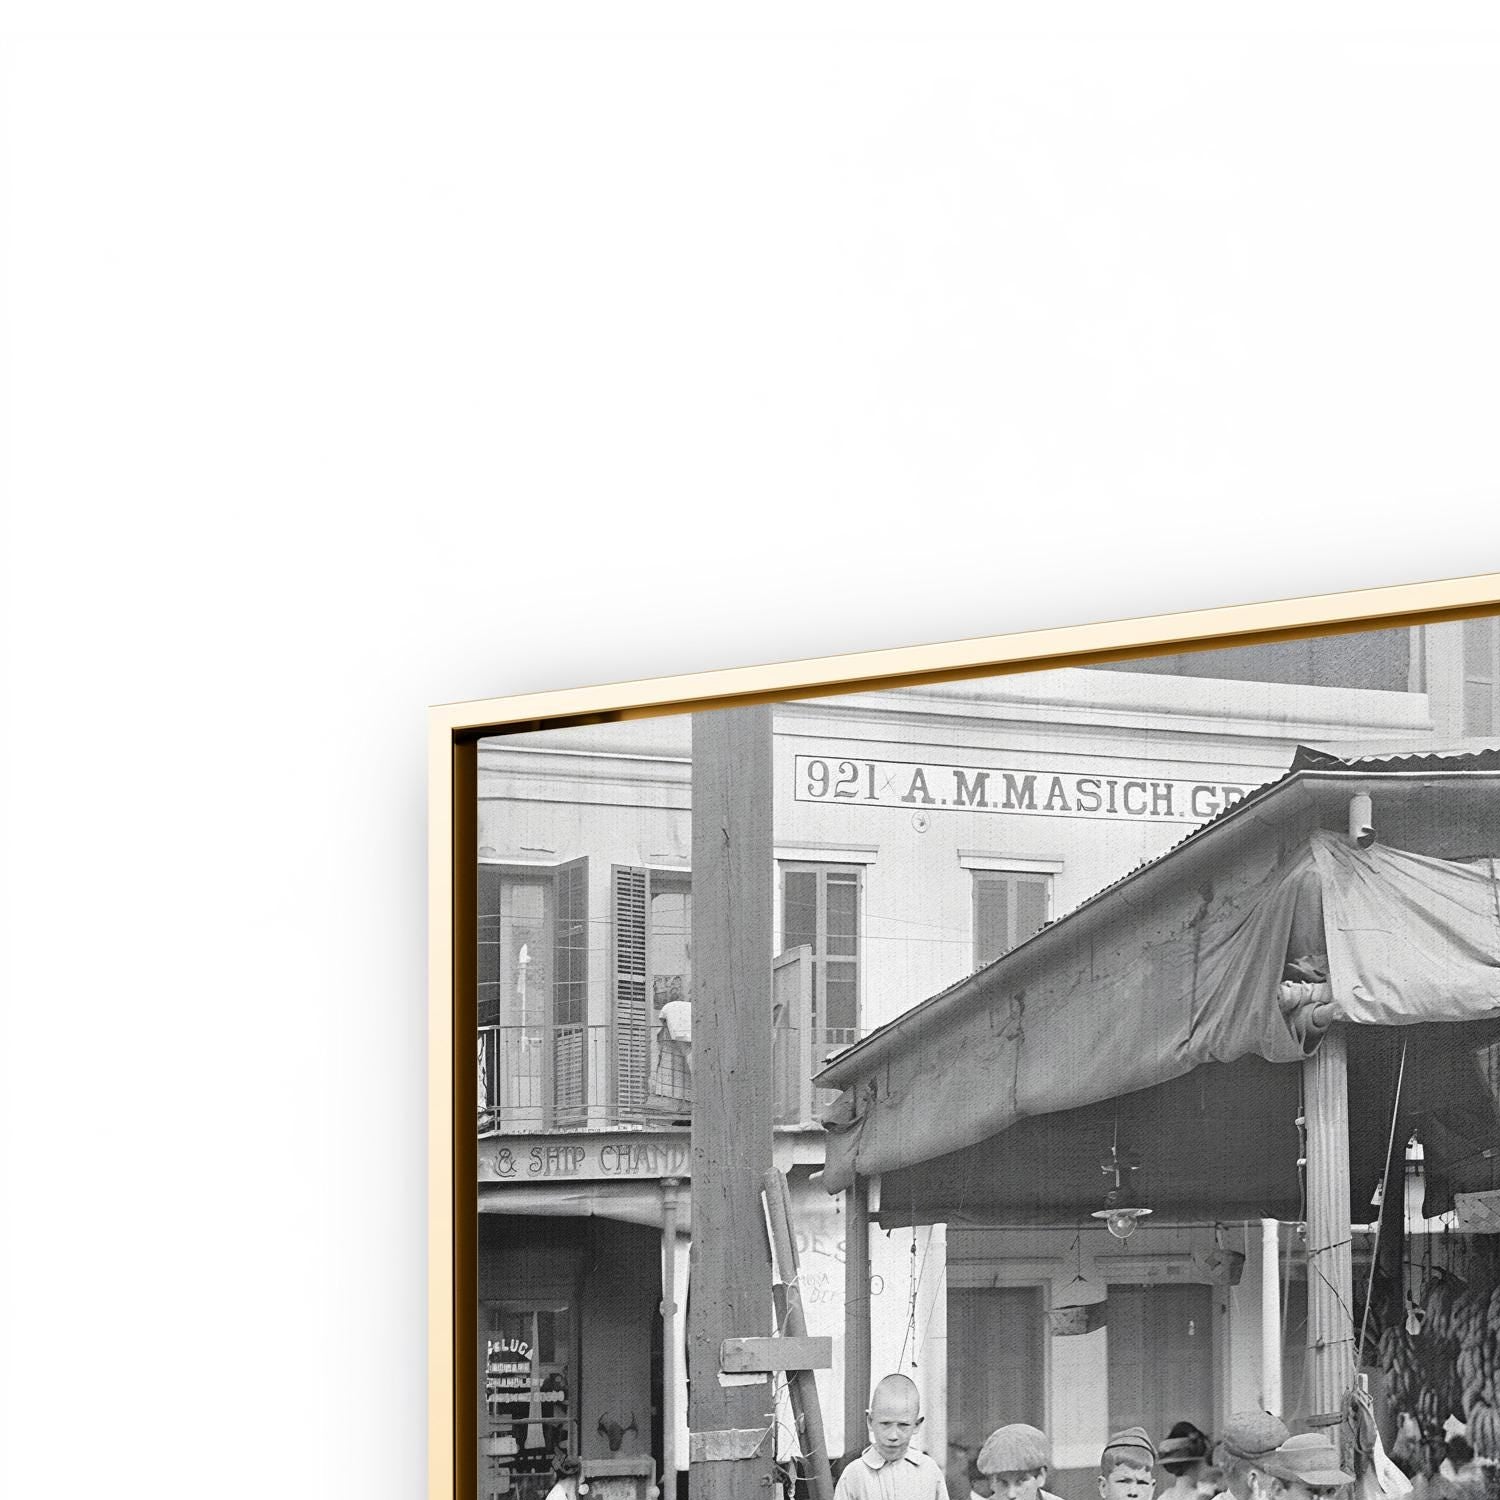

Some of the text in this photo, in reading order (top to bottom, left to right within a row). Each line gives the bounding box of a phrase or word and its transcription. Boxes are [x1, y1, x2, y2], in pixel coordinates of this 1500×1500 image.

[807, 759, 880, 801] 921
[494, 1147, 518, 1178] &
[528, 1145, 586, 1177] SHIP
